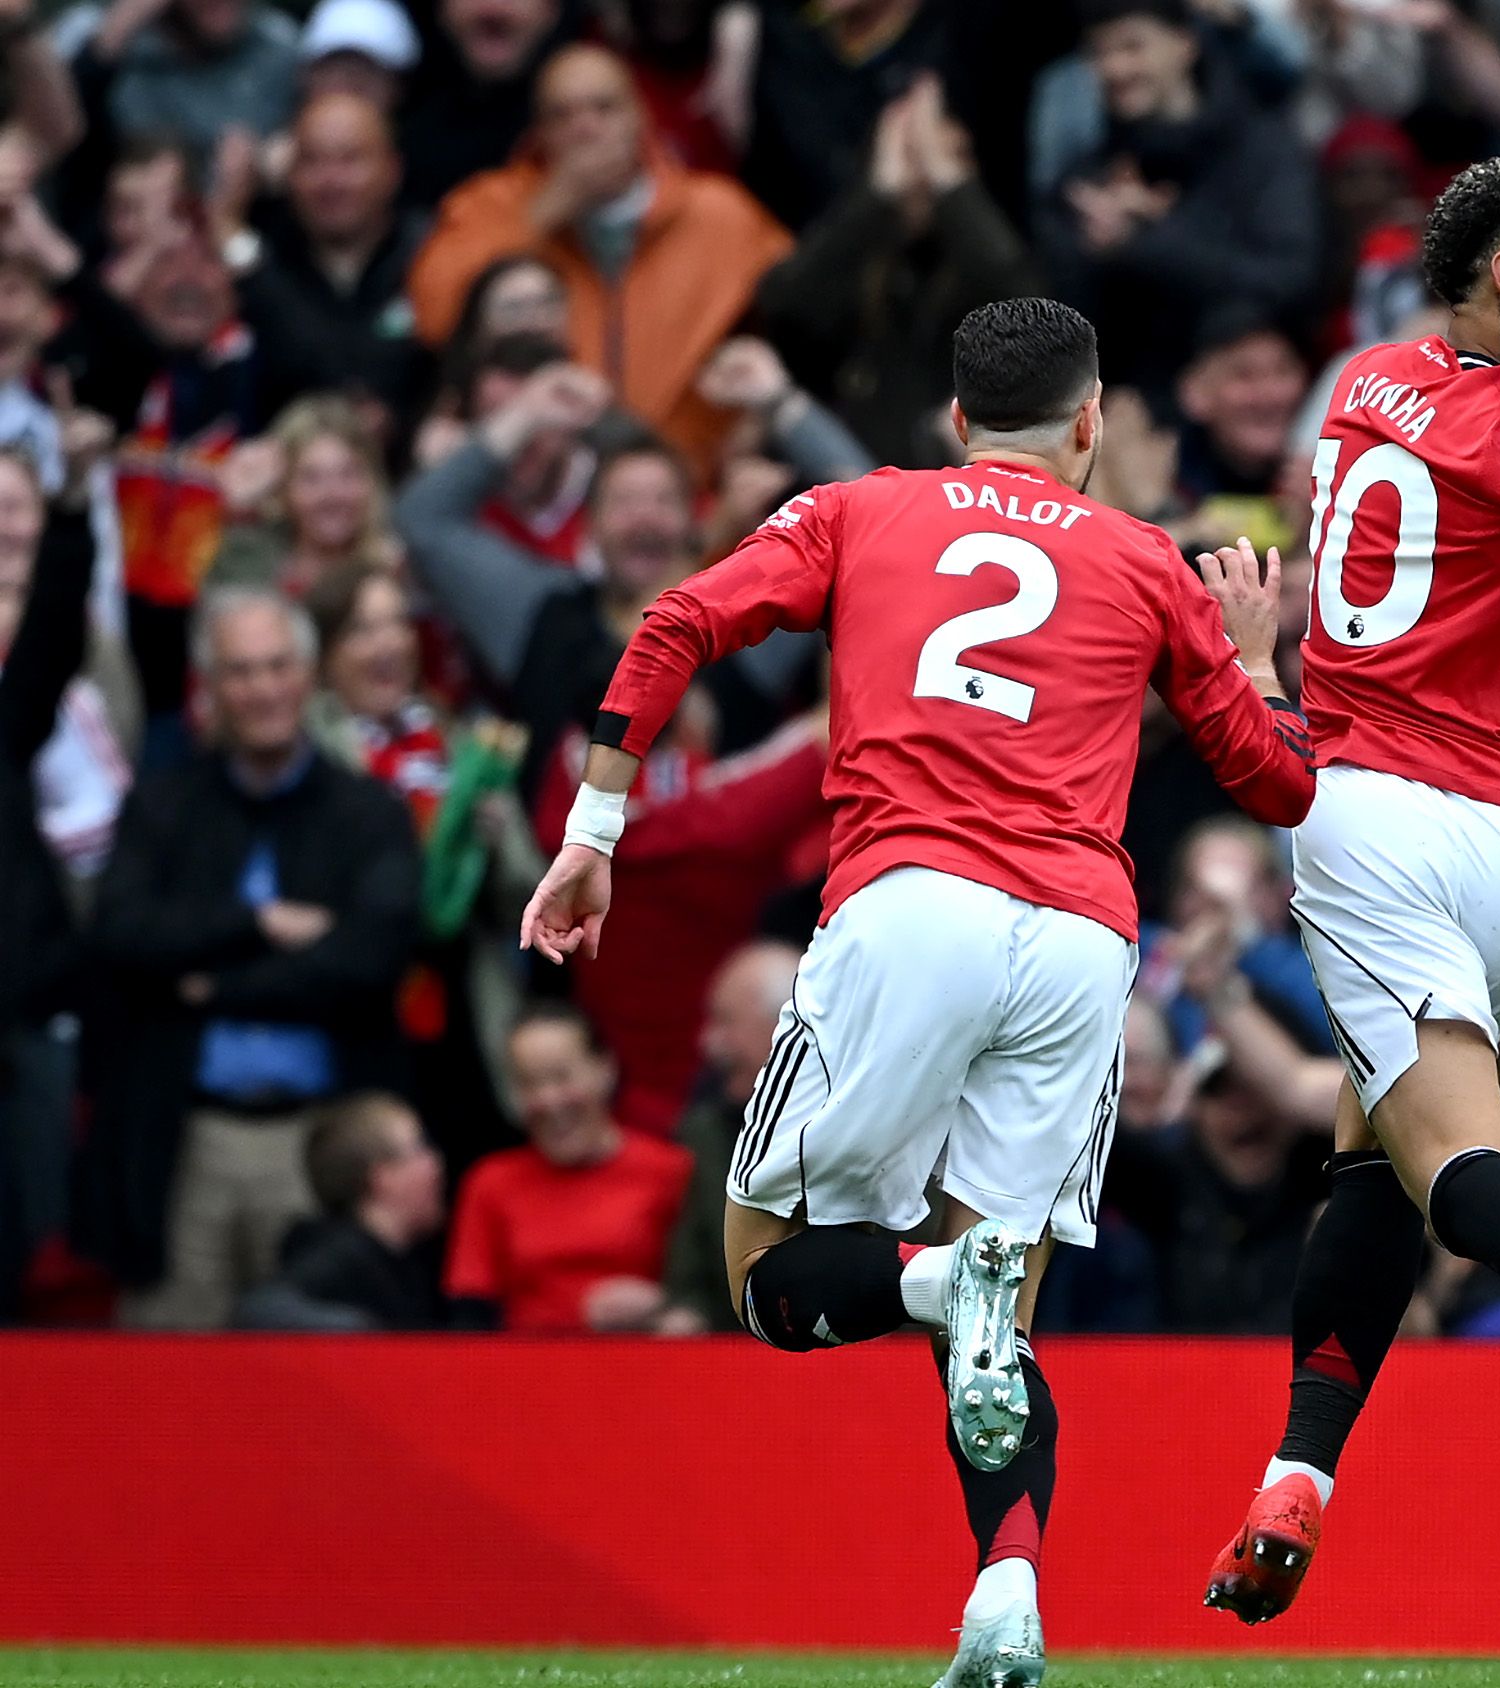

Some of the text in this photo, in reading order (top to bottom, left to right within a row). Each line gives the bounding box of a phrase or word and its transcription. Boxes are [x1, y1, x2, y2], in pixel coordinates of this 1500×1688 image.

[1344, 372, 1437, 444] CUNHA
[941, 481, 1093, 530] DALOT
[912, 531, 1060, 724] 2
